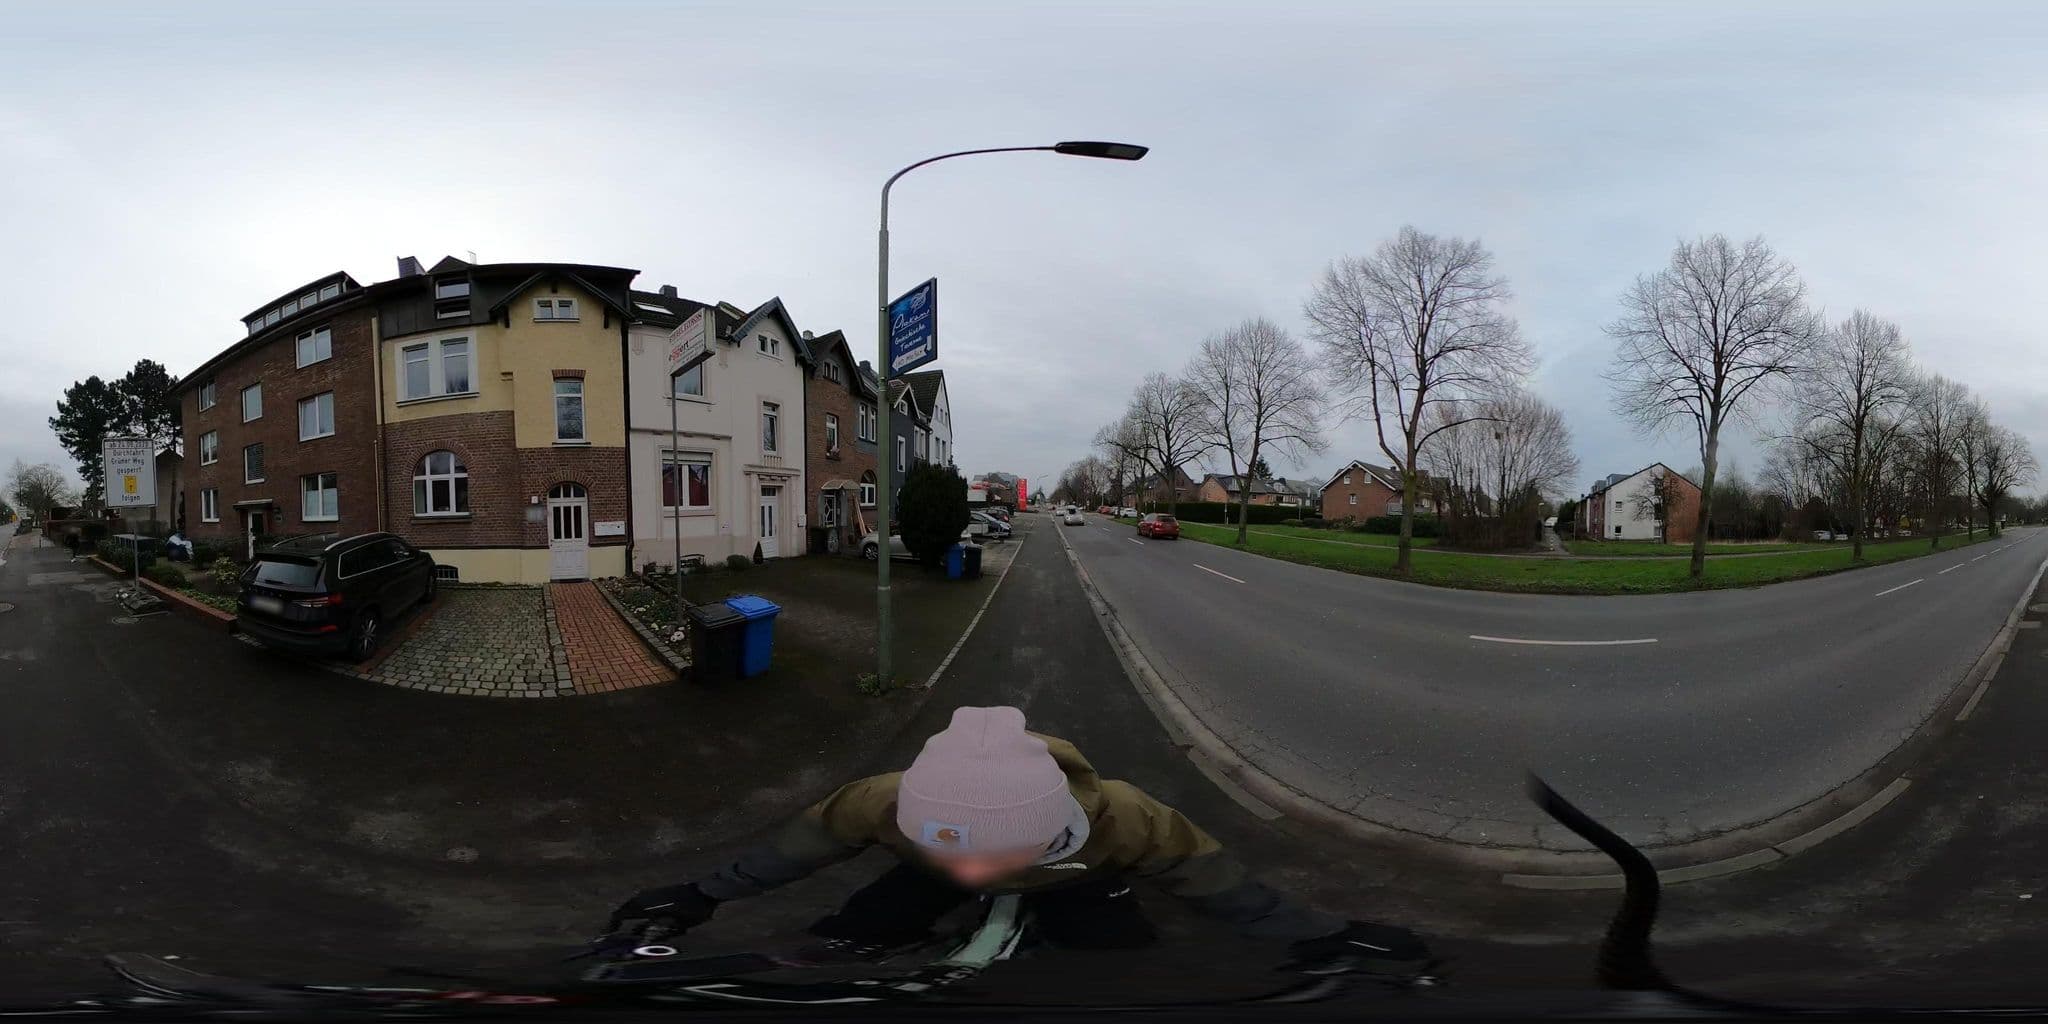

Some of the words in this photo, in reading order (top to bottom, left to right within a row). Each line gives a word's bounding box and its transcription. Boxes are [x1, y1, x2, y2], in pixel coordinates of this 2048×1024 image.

[132, 458, 145, 466] Weg
[116, 467, 142, 475] gesperrt
[121, 494, 141, 503] folgen
